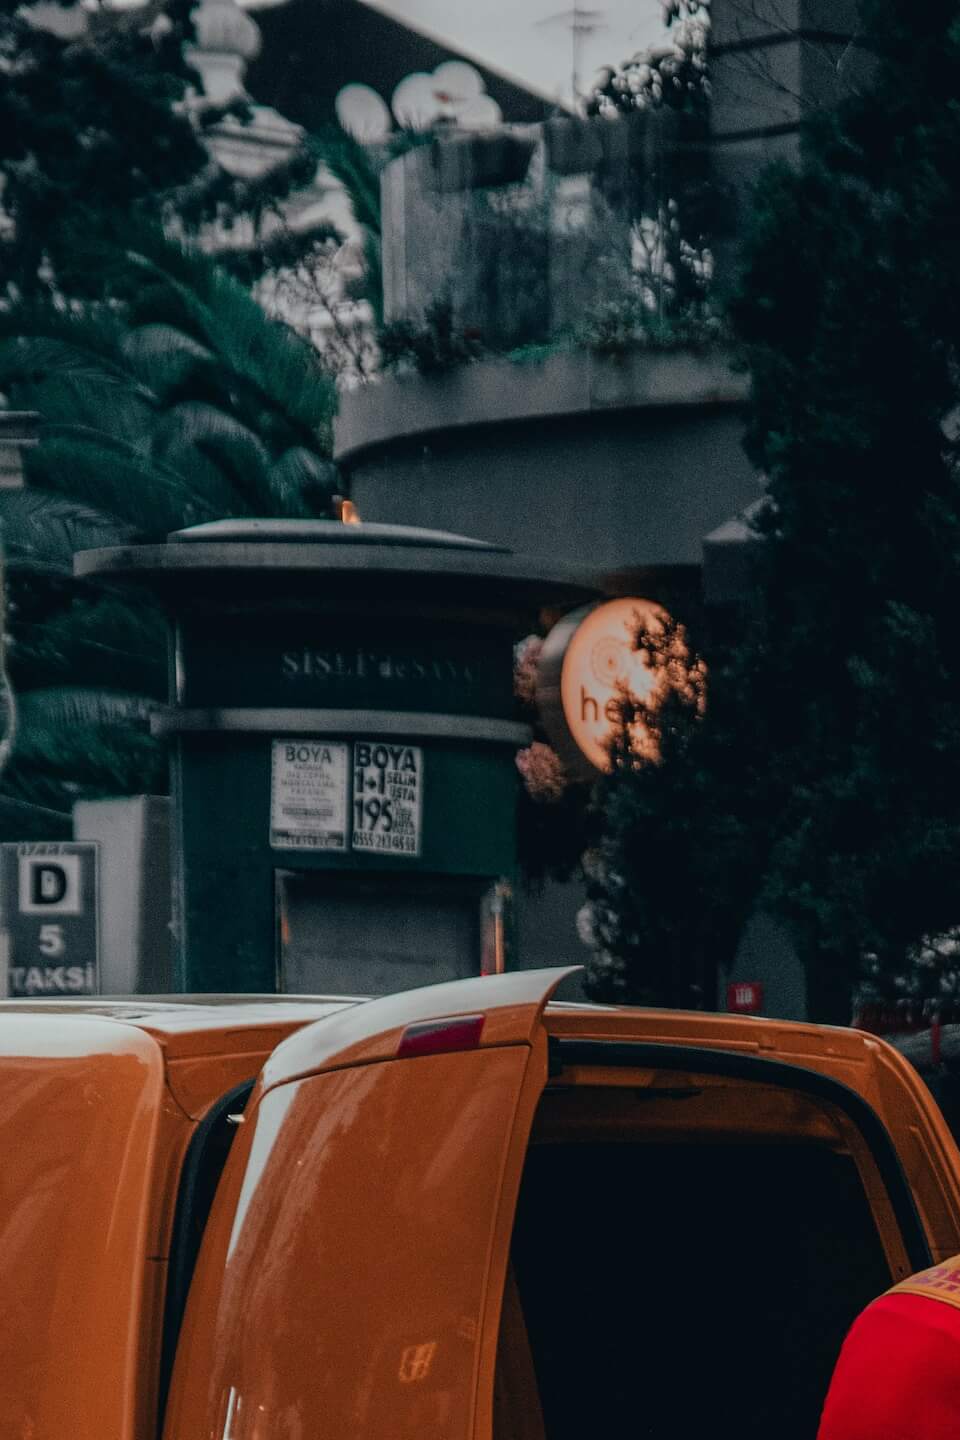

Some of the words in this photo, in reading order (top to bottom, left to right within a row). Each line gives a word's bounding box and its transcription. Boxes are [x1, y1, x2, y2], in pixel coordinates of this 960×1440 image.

[286, 745, 332, 764] BOYA
[355, 744, 417, 773] BOYA
[354, 797, 393, 832] 195
[31, 862, 66, 905] D
[39, 923, 64, 959] 5
[9, 961, 96, 992] TAKSİ
